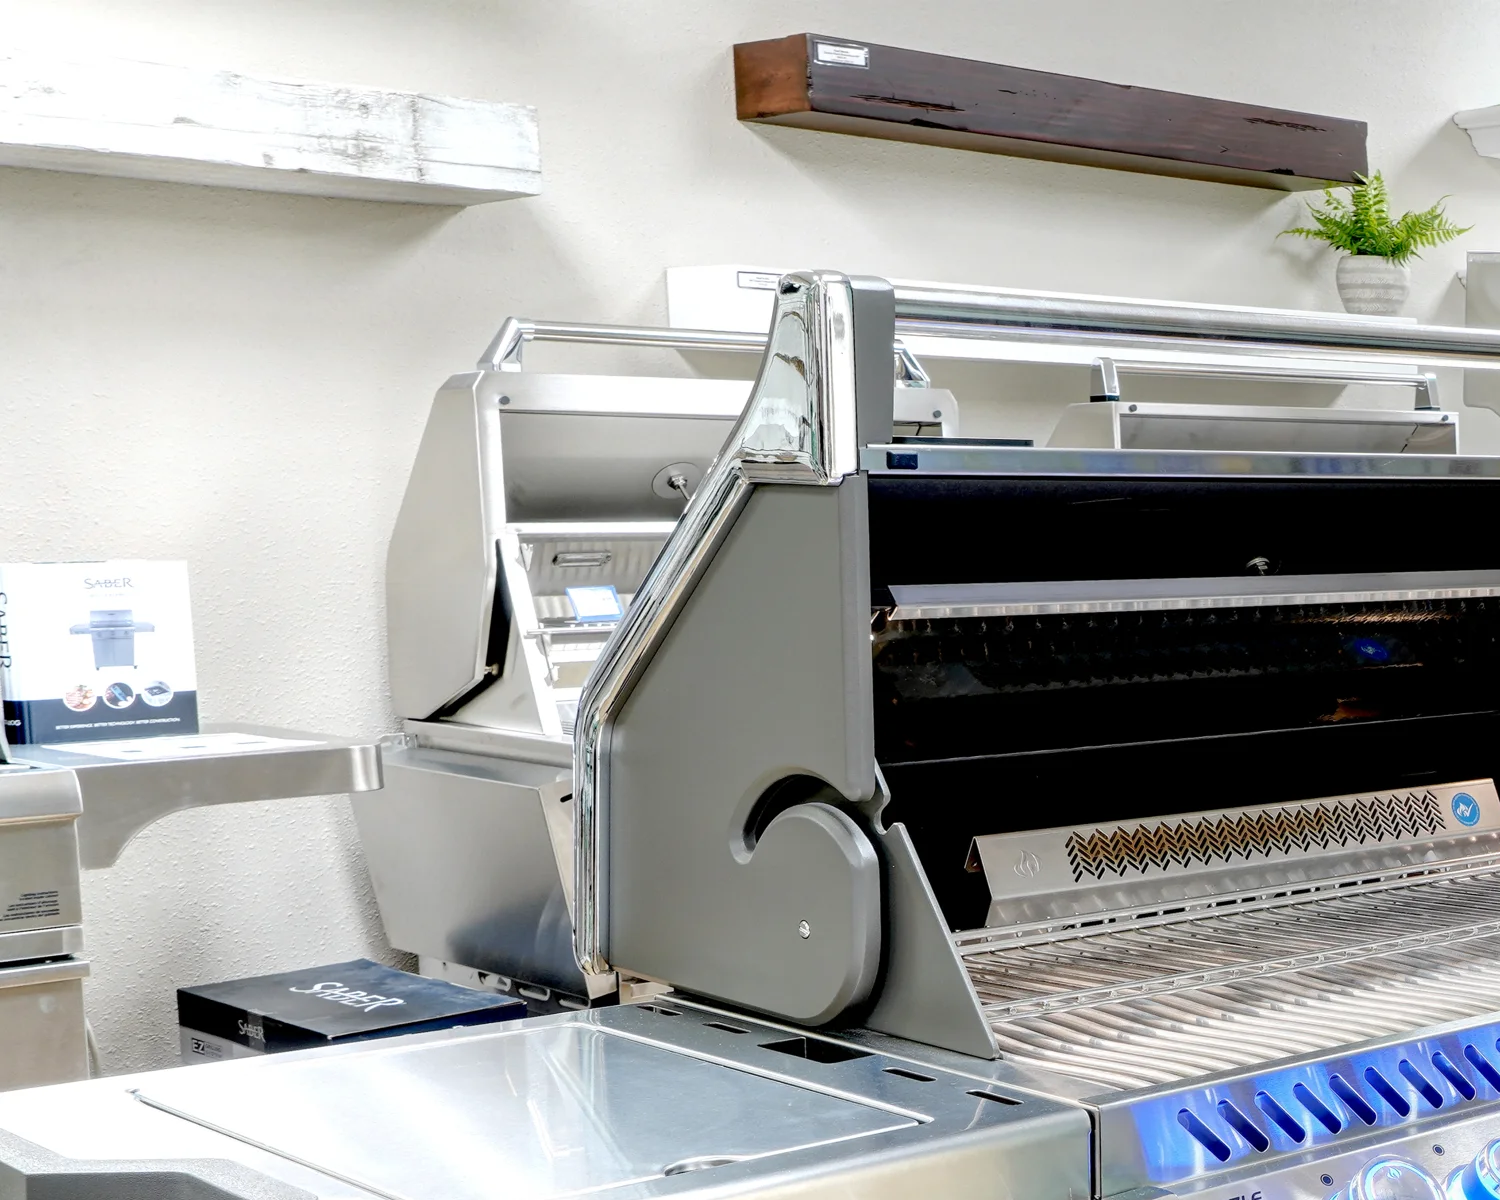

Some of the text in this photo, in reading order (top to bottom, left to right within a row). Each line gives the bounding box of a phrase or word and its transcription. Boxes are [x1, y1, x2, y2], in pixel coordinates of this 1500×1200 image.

[84, 577, 133, 589] SABER
[290, 982, 405, 1012] SABER
[238, 1019, 265, 1043] SABER
[192, 1039, 205, 1054] EZ
